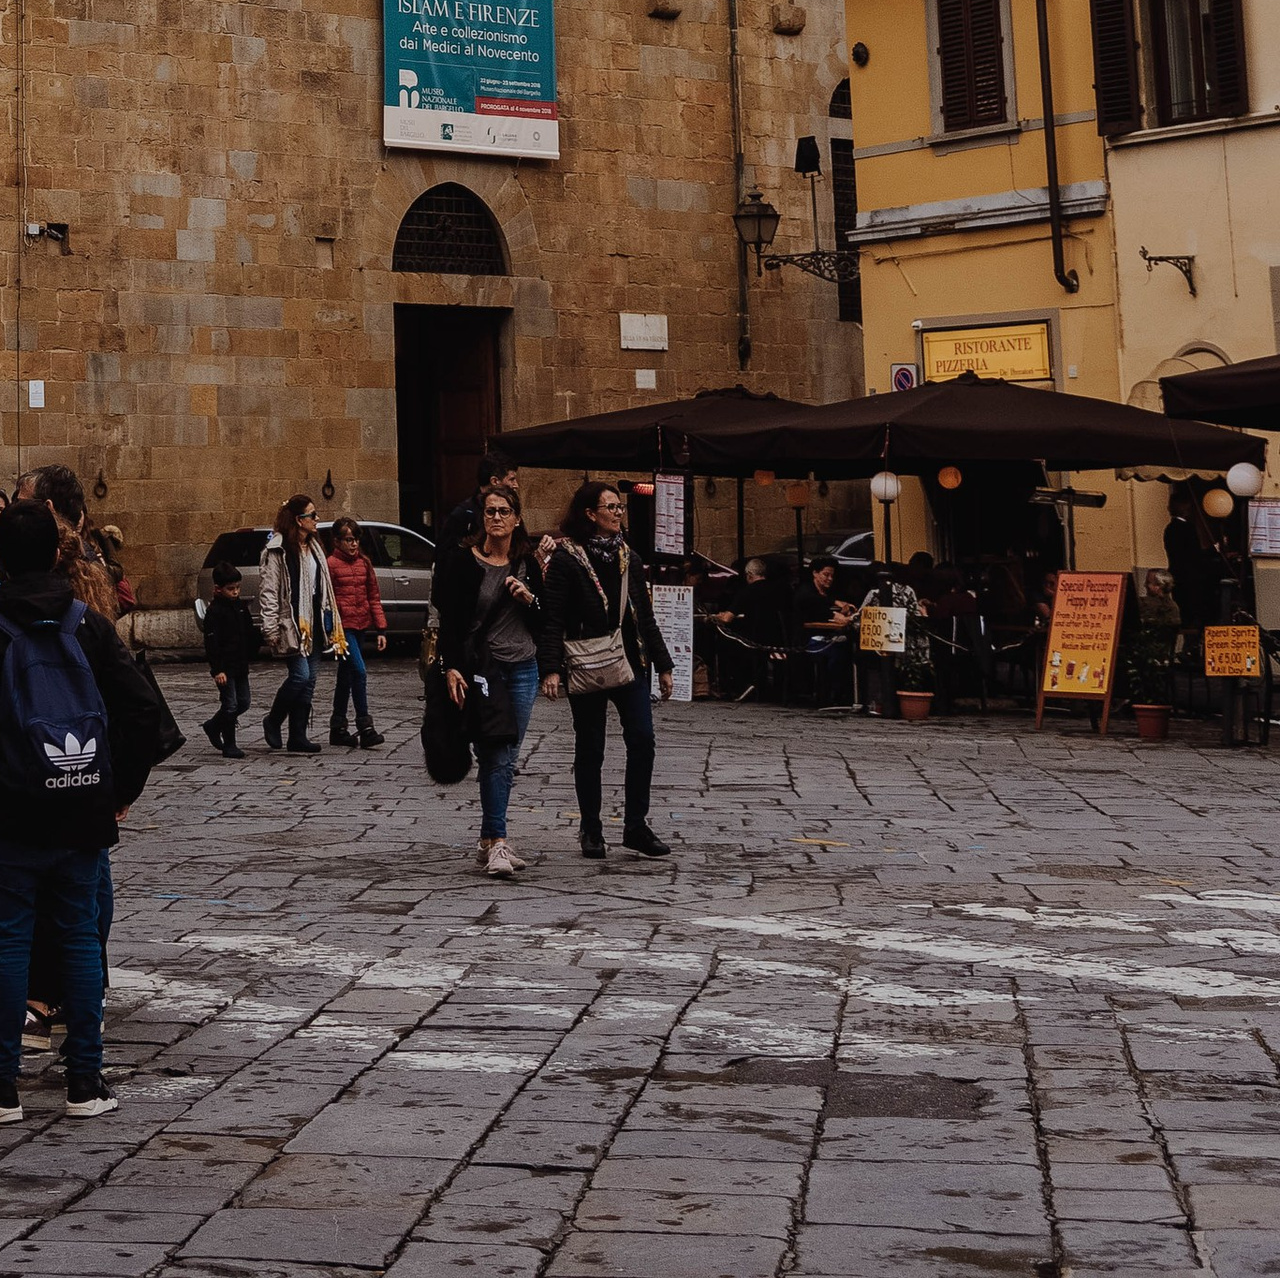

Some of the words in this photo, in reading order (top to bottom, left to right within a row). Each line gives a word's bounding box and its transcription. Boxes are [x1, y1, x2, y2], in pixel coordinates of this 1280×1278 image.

[454, 1, 464, 20] E
[469, 3, 540, 28] FIRENZE
[412, 20, 438, 36] Arte
[440, 27, 448, 37] e
[451, 26, 528, 45] collezionismo
[399, 36, 418, 50] dai
[422, 38, 461, 55] Medici
[464, 43, 474, 56] al
[477, 45, 540, 62] Novecento
[421, 87, 445, 97] MUSEO
[421, 95, 458, 105] NAZIONALE
[480, 103, 510, 111] PROROGATA
[954, 337, 1032, 355] RISTORANTE
[935, 357, 989, 374] PIZZERIA
[1060, 579, 1085, 594] Special
[1066, 594, 1089, 611] Happy
[1089, 593, 1109, 607] drink
[862, 608, 887, 623] Mojito
[1055, 610, 1070, 619] From
[1207, 627, 1229, 640] Aperol
[1231, 627, 1257, 640] Spritz
[862, 637, 870, 646] All
[870, 638, 884, 649] Day
[1206, 639, 1229, 649] Green
[1231, 639, 1257, 651] Spritz
[1215, 666, 1226, 674] All
[1228, 666, 1245, 675] Day
[45, 772, 101, 789] adidas
